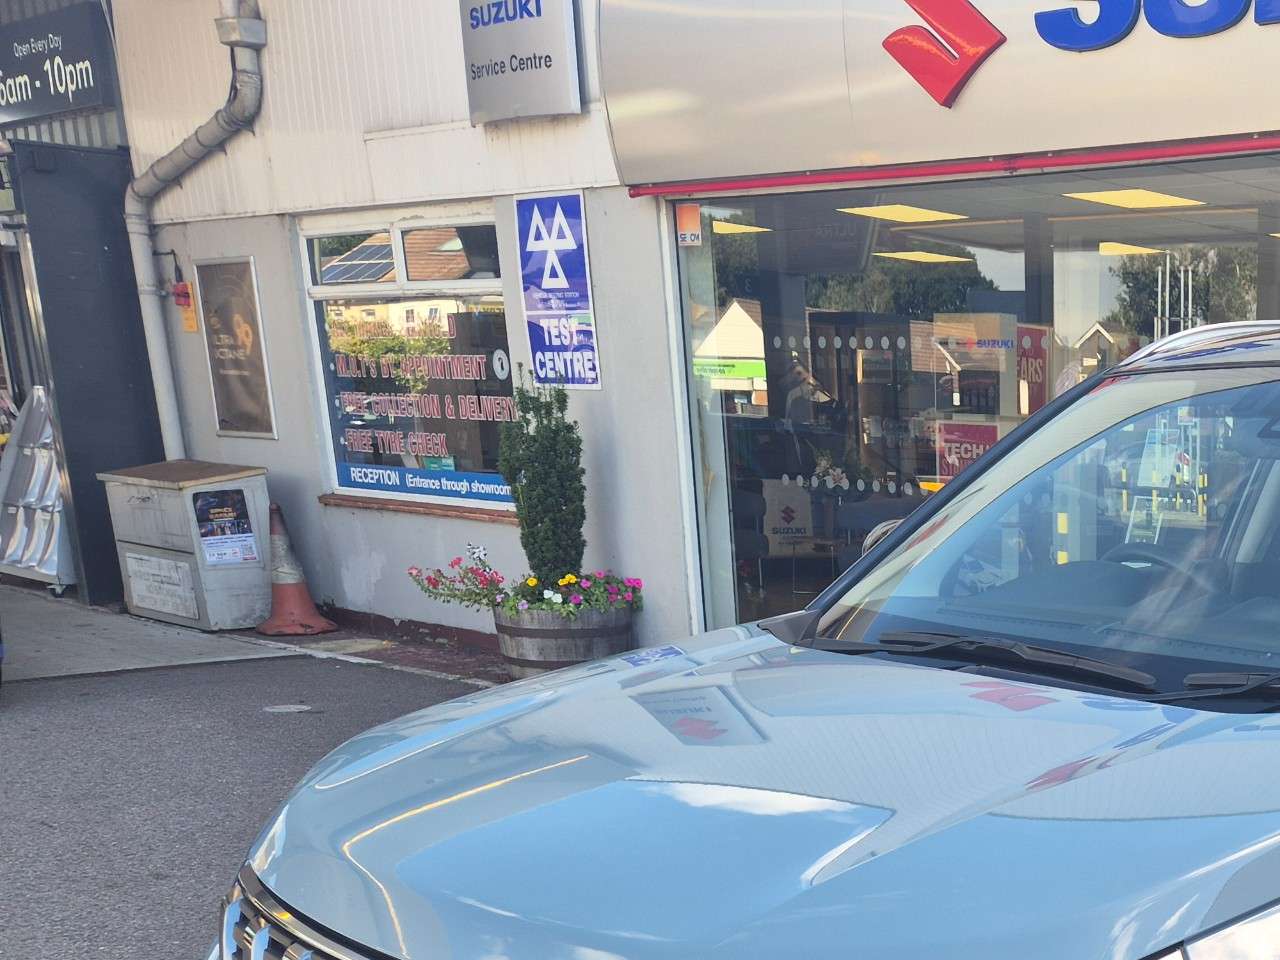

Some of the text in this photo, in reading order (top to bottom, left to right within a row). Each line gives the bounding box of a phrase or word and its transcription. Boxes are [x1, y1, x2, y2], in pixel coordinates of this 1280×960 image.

[469, 0, 542, 29] SUZUKI
[13, 33, 62, 59] Open Every Day
[43, 55, 94, 103] 10pm
[470, 52, 553, 81] Service Centre
[539, 318, 579, 346] TEST
[976, 339, 1014, 349] SUZUKI
[399, 354, 487, 380] APPOINTMENT
[535, 351, 597, 379] CENTRE
[340, 391, 519, 422] FREE COLLECTION & DELIVERY
[345, 428, 449, 457] FREE TYRE CHECK
[351, 467, 512, 496] RECEPTION (Entrance through showroom
[771, 527, 807, 535] SUZUKI
